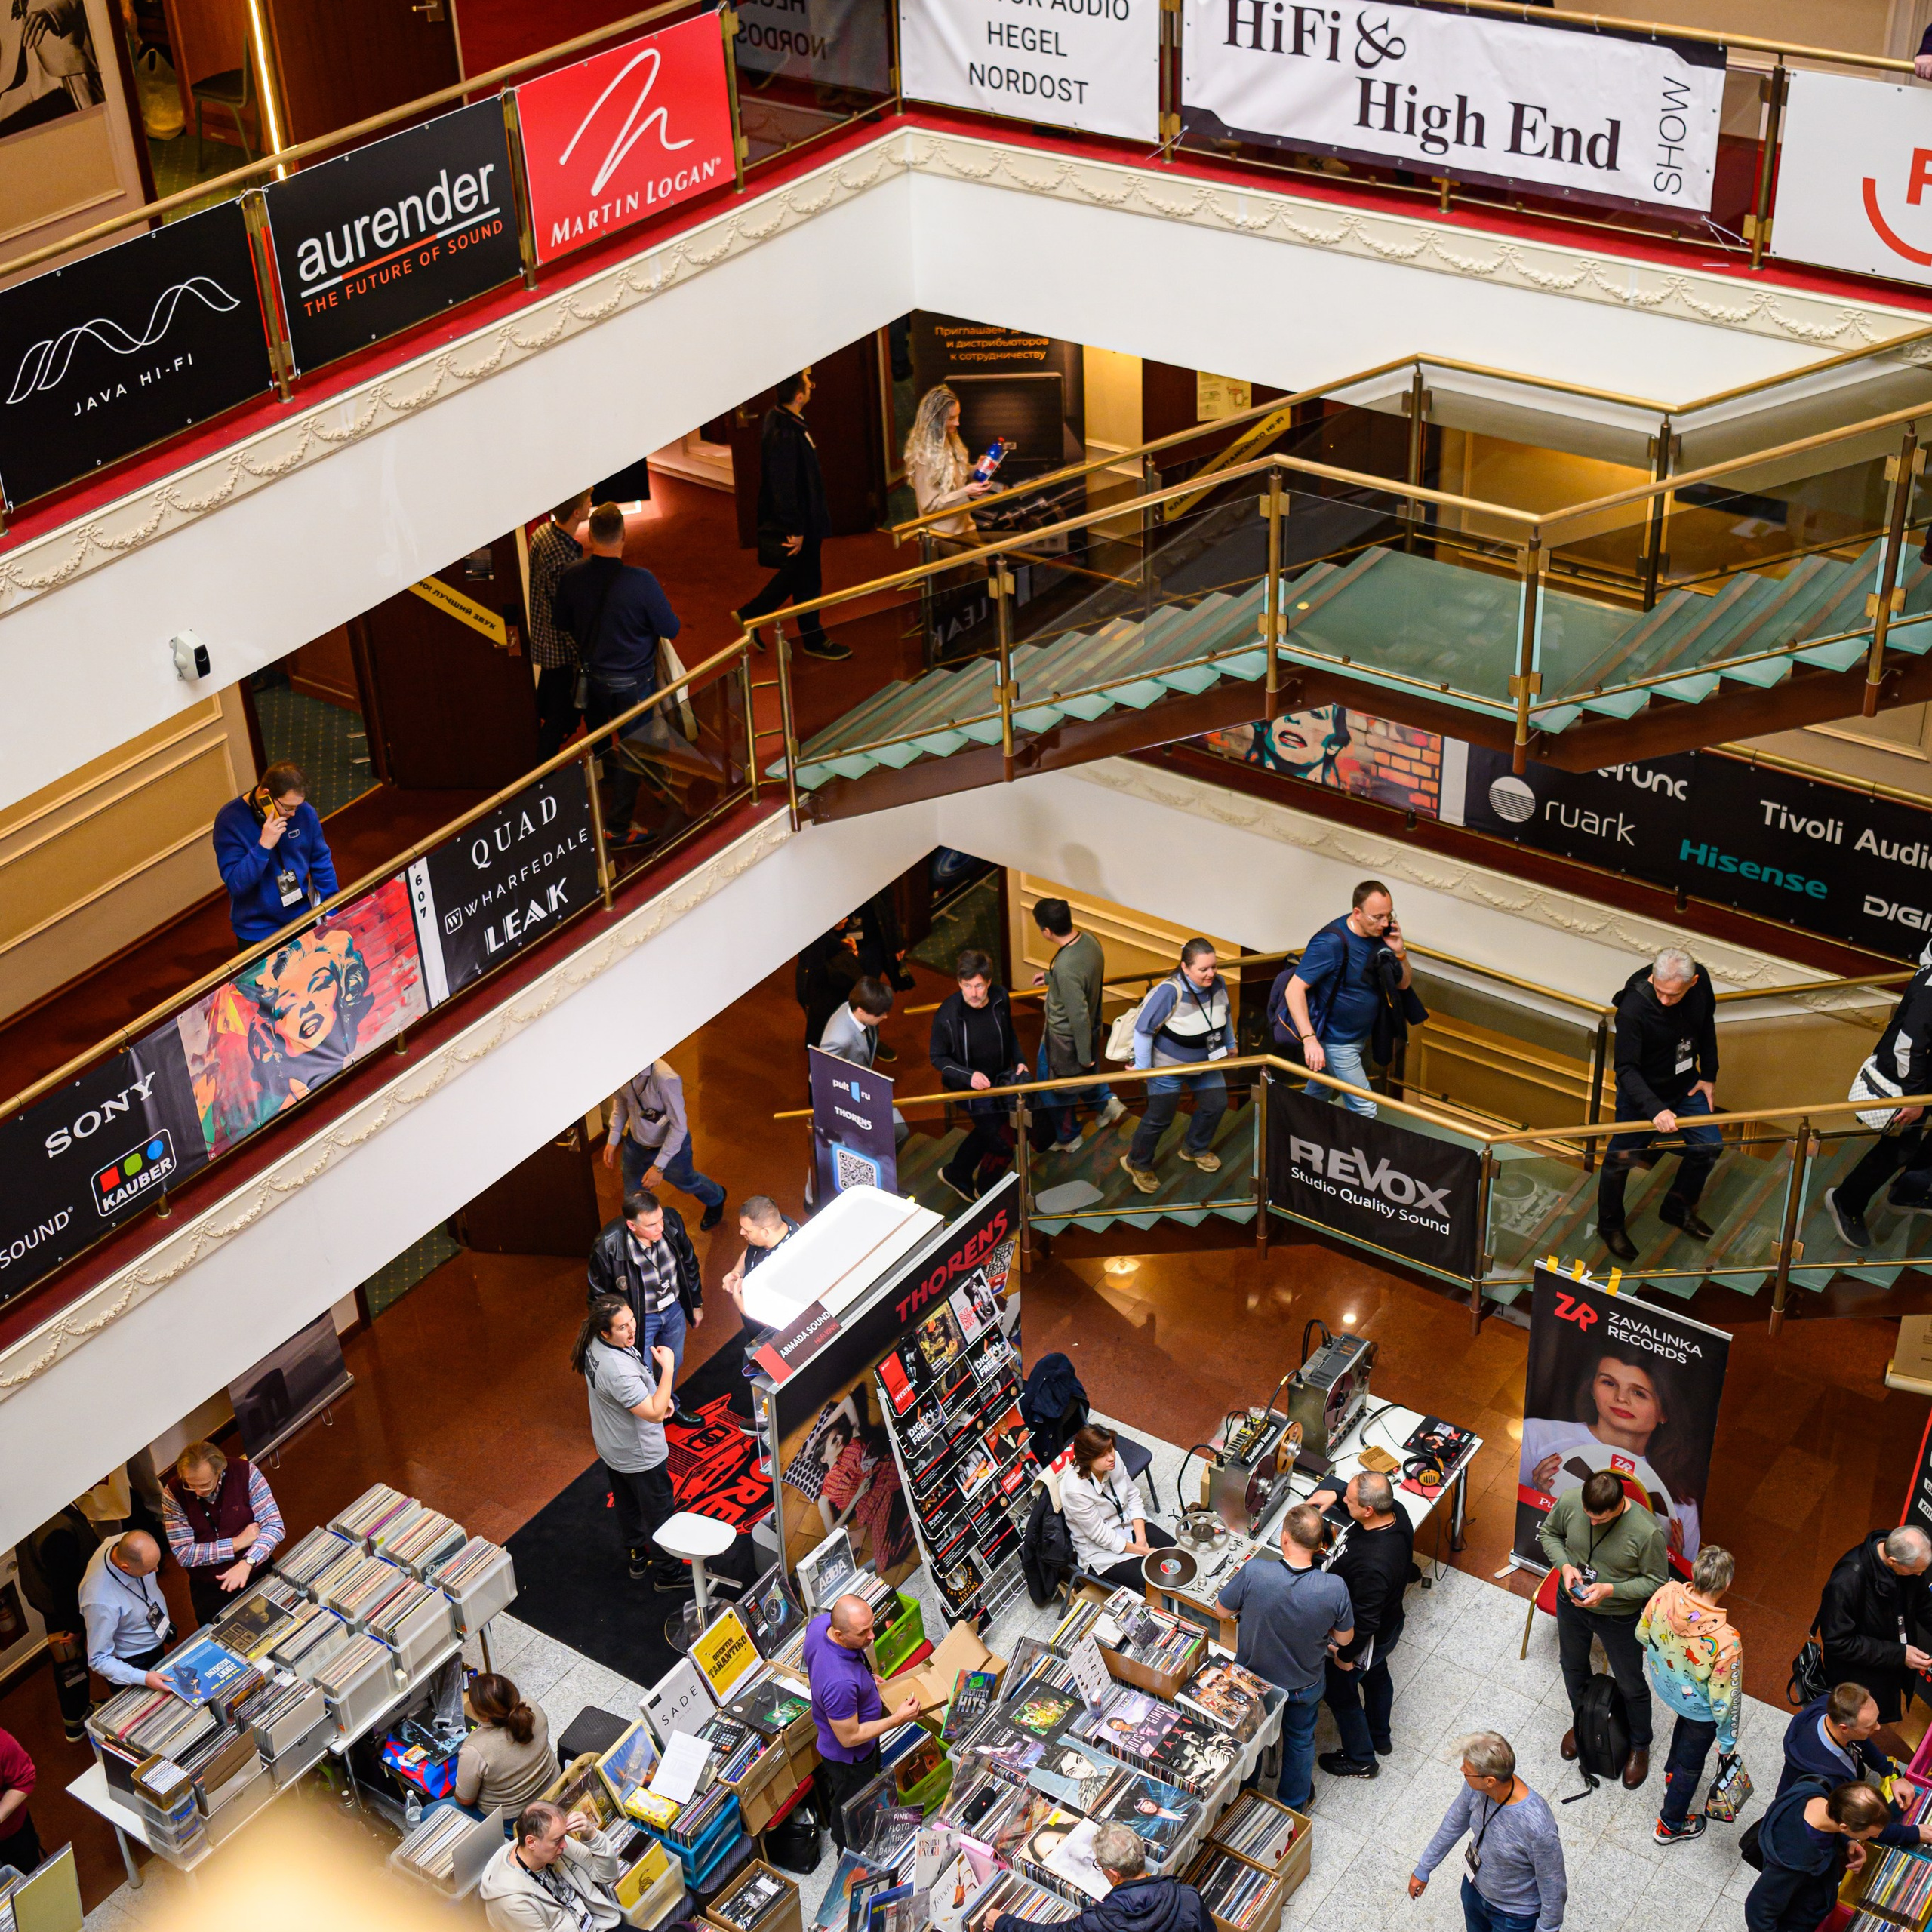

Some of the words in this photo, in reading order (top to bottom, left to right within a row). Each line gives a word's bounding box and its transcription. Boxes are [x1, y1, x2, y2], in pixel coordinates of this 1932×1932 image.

[988, 21, 1068, 57] HEGEL
[1223, 0, 1341, 63] HiFi
[1354, 10, 1407, 69] &
[970, 62, 1089, 105] NORDOST
[1354, 76, 1486, 157] High
[1504, 101, 1620, 171] End
[1654, 76, 1690, 195] SHOW
[297, 163, 494, 281] aurender
[551, 191, 639, 248] MARTIN
[303, 297, 339, 318] THE
[346, 260, 413, 300] FUTURE
[419, 246, 441, 266] OF
[448, 220, 503, 255] SOUND
[934, 326, 1007, 337] Приглашаем
[956, 338, 1049, 349] дистрибьюторов
[959, 352, 1046, 361] сотрудничеству
[73, 383, 127, 416] JAVA
[140, 354, 194, 383] HI-FI
[1266, 416, 1284, 432] HI-FI
[432, 589, 473, 615] ЛУЧШИЙ
[473, 614, 497, 630] ЗВУК
[472, 796, 557, 869] QUAD
[1546, 801, 1635, 846] ruark
[1760, 799, 1844, 845] Tivoli
[1854, 829, 1932, 870] Audi
[464, 828, 588, 917] WHARFEDALE
[1679, 838, 1828, 900] Hisense
[415, 875, 426, 919] 607
[484, 878, 568, 955] LEAK
[1863, 894, 1932, 934] DIGI
[832, 1079, 850, 1091] pult
[45, 1071, 156, 1158] SONY
[834, 1106, 872, 1131] THORENS
[101, 1156, 172, 1212] KAUBER
[1290, 1134, 1451, 1220] REVOX
[1291, 1166, 1337, 1198] Studio
[1340, 1183, 1394, 1220] Quality
[1398, 1208, 1451, 1236] Sound
[895, 1209, 1008, 1323] THORENS
[1553, 1291, 1598, 1332] ZR
[780, 1331, 810, 1358] ARMADA
[806, 1311, 831, 1334] SOUND
[1607, 1310, 1703, 1358] ZAVALINKA
[1607, 1324, 1688, 1365] RECORDS
[975, 1342, 1004, 1370] DIGITAL
[979, 1357, 997, 1377] FREE
[894, 1379, 918, 1404] MYSTERIA
[909, 1409, 937, 1438] DIGITAL
[912, 1426, 931, 1446] FREE
[1245, 1441, 1265, 1463] Zavalinka
[1261, 1424, 1278, 1447] Records
[1001, 1471, 1017, 1486] FRANZ
[1004, 1469, 1027, 1491] SCHUBERT
[1614, 1457, 1633, 1472] ZR
[979, 1533, 1000, 1552] Siberians
[819, 1559, 847, 1592] ABBA
[205, 1658, 232, 1678] RUSHING
[708, 1635, 748, 1679] TARANTINO
[712, 1637, 734, 1662] QUENTIN
[216, 1663, 238, 1680] JIMMY
[661, 1685, 698, 1726] SADE
[955, 1697, 987, 1715] HITS
[961, 1687, 990, 1697] GREATEST
[997, 1729, 1014, 1746] test
[1124, 1730, 1146, 1753] BOYS
[888, 1823, 910, 1832] FLOYD
[894, 1812, 909, 1820] PINK
